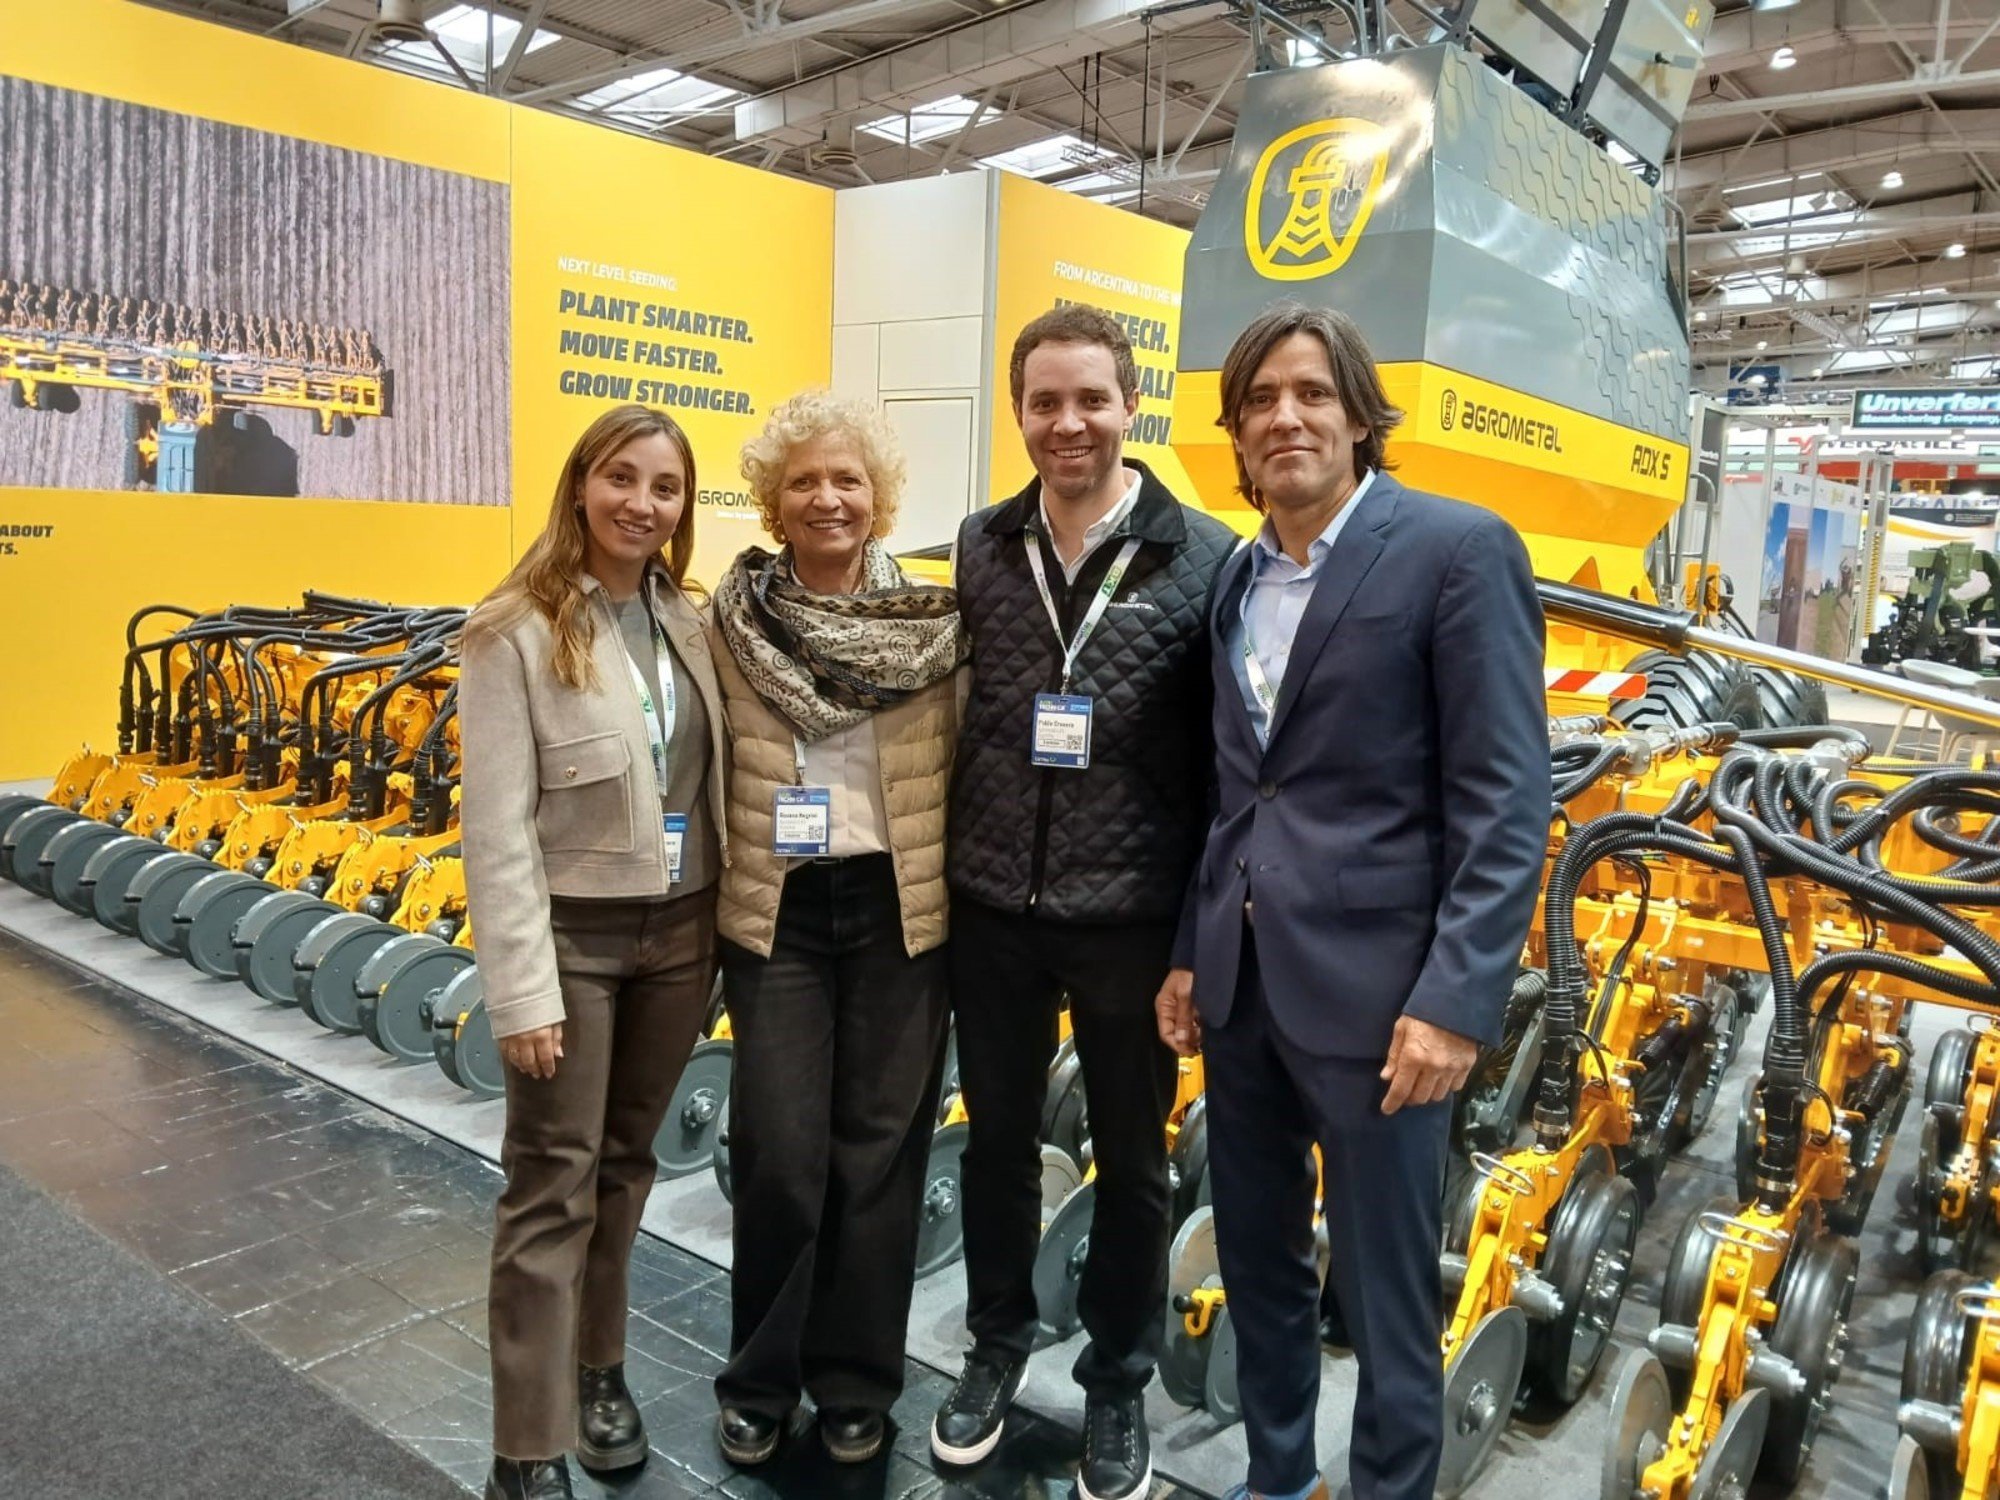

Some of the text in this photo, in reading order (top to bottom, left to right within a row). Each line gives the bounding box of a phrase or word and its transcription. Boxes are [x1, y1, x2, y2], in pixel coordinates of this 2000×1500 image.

[558, 256, 590, 275] NEXT
[592, 263, 626, 282] LEVEL
[1053, 260, 1083, 281] FROM
[1084, 270, 1138, 297] ARGENTINA
[1140, 283, 1151, 300] TO
[1152, 286, 1170, 305] THE
[559, 289, 753, 344] PLANT SMARTER.
[560, 329, 723, 375] MOVE FASTER.
[560, 370, 755, 415] GROW STRONGER.
[1136, 365, 1174, 400] ALI
[1122, 412, 1171, 446] NOV
[1860, 413, 1940, 425] Manufacturing
[1631, 444, 1671, 480] ADX S
[0, 525, 54, 538] ABOUT
